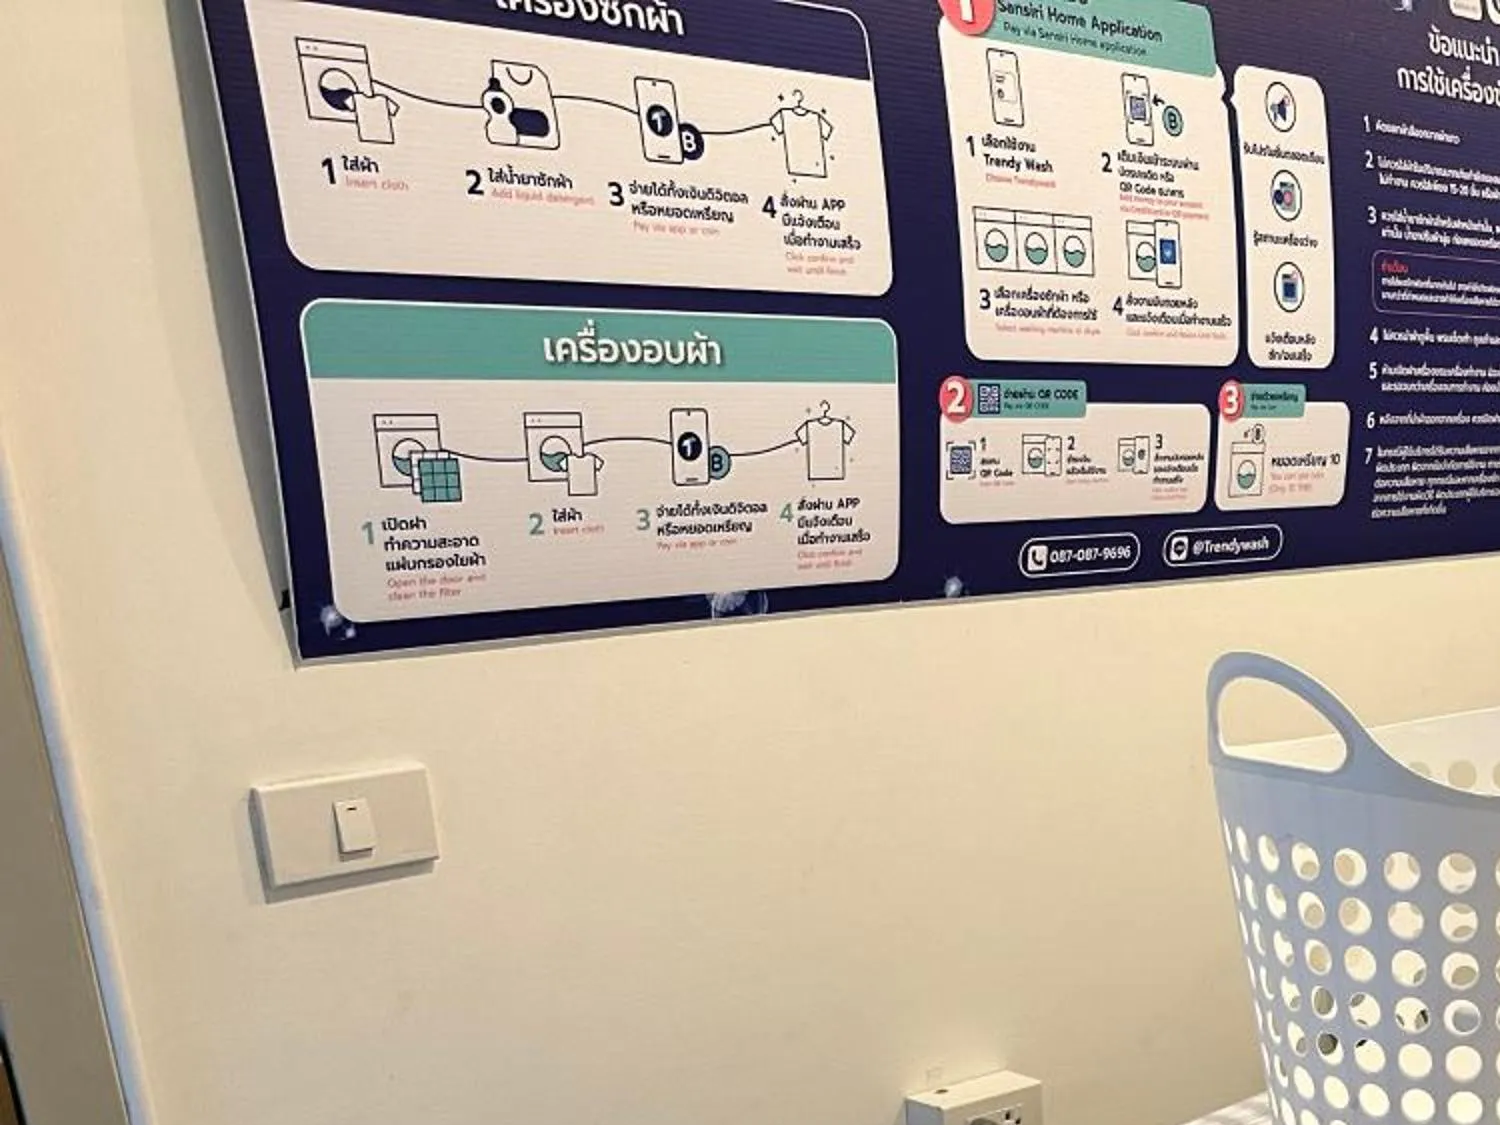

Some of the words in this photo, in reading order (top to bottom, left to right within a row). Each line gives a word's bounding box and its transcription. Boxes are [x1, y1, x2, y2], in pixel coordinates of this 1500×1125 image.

[1047, 8, 1087, 28] Home
[1091, 16, 1163, 42] Application
[1427, 24, 1500, 67] ข้อแนะนำ
[1363, 115, 1370, 133] 1
[966, 135, 975, 157] 1
[321, 157, 337, 184] 1
[342, 155, 379, 173] ใส่ผ้า
[984, 154, 1021, 172] Trendy
[1024, 157, 1053, 173] Wash
[1101, 152, 1113, 173] 2
[1365, 150, 1374, 169] 2
[465, 169, 484, 195] 2
[488, 163, 573, 190] ใส่น้ำยาซักผ้า
[1120, 181, 1133, 194] QR
[1135, 183, 1156, 196] Code
[607, 181, 625, 206] 3
[762, 195, 778, 219] 4
[821, 198, 845, 212] APP
[1367, 206, 1377, 225] 3
[980, 289, 991, 310] 3
[1112, 296, 1123, 316] 4
[543, 319, 722, 366] เครื่องอบผ้า
[1369, 327, 1378, 344] 4
[1369, 362, 1377, 380] 5
[947, 382, 965, 414] 2
[1038, 389, 1051, 400] QR
[1054, 388, 1079, 400] CODE
[1224, 386, 1238, 415] 3
[1367, 411, 1375, 429] 6
[1067, 436, 1075, 450] 2
[1155, 433, 1163, 449] 3
[1330, 454, 1340, 465] 10
[1365, 448, 1373, 465] 7
[636, 509, 651, 531] 3
[780, 503, 794, 523] 4
[837, 498, 860, 509] APP
[529, 513, 545, 536] 2
[552, 507, 583, 523] ใส่ผ้า
[361, 521, 375, 545] 1
[384, 535, 480, 552] ทำความสะอาด
[1192, 536, 1270, 556] @Trendywash
[385, 552, 486, 572] แผ่นกรองใยผ้า
[1050, 545, 1131, 564] 087-087-9696
